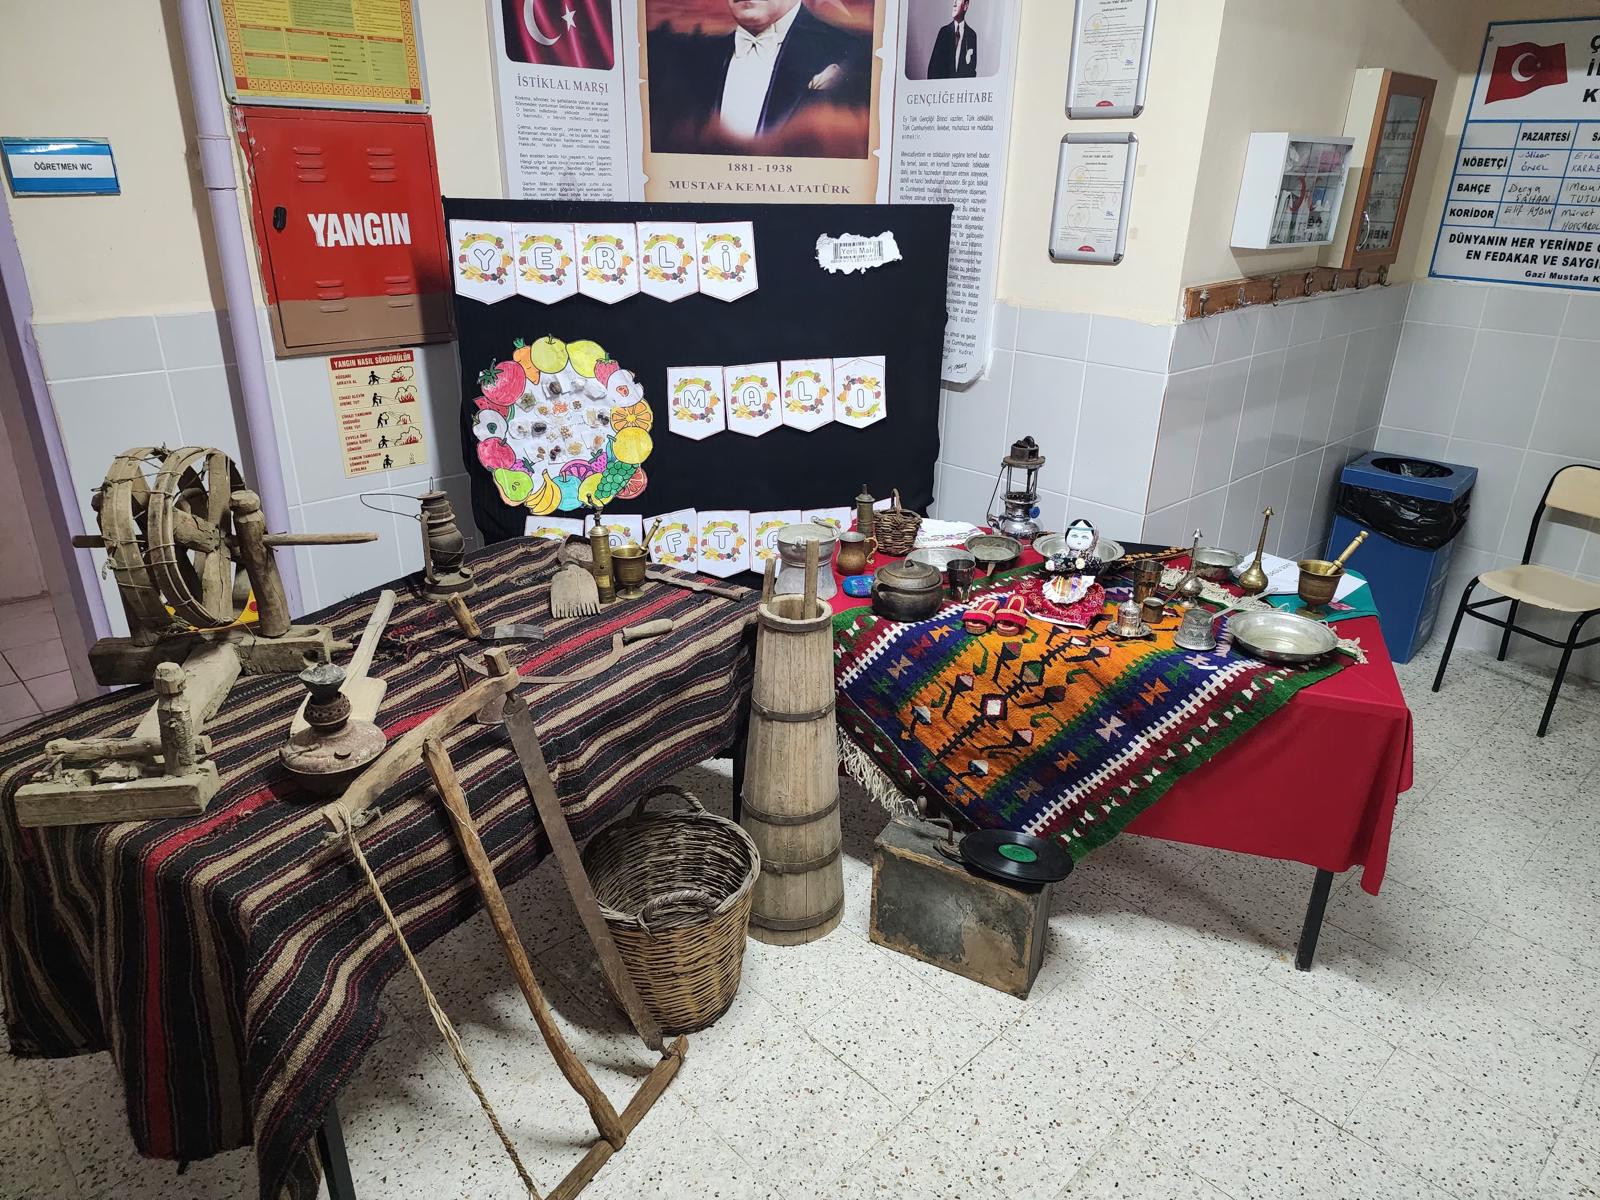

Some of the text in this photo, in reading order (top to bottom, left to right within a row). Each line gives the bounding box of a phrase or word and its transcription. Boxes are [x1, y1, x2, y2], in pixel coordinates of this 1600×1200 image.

[517, 73, 609, 95] İSTİKLAL MARŞI
[906, 90, 994, 106] GENÇLİĞE HİTABE
[1521, 130, 1572, 142] PAZARTESİ
[33, 161, 93, 171] ÖĞRETMEN WC
[728, 162, 755, 172] 1881
[766, 164, 793, 173] 1938
[1462, 156, 1509, 169] NÖBETÇİ
[669, 180, 850, 194] MUSTAFA KEMAL ATATÜRK
[1456, 183, 1491, 195] BAHÇE
[1449, 206, 1495, 219] KORİDOR
[307, 212, 412, 247] YANGIN
[1448, 232, 1593, 252] DÜNYANIN HER YERİNDE
[1465, 250, 1600, 269] EN FEDAKAR VE SAYGI
[1524, 270, 1546, 279] Gazi
[1549, 272, 1589, 282] Mustafa
[333, 358, 357, 369] YANGIN
[356, 357, 374, 366] NASIL
